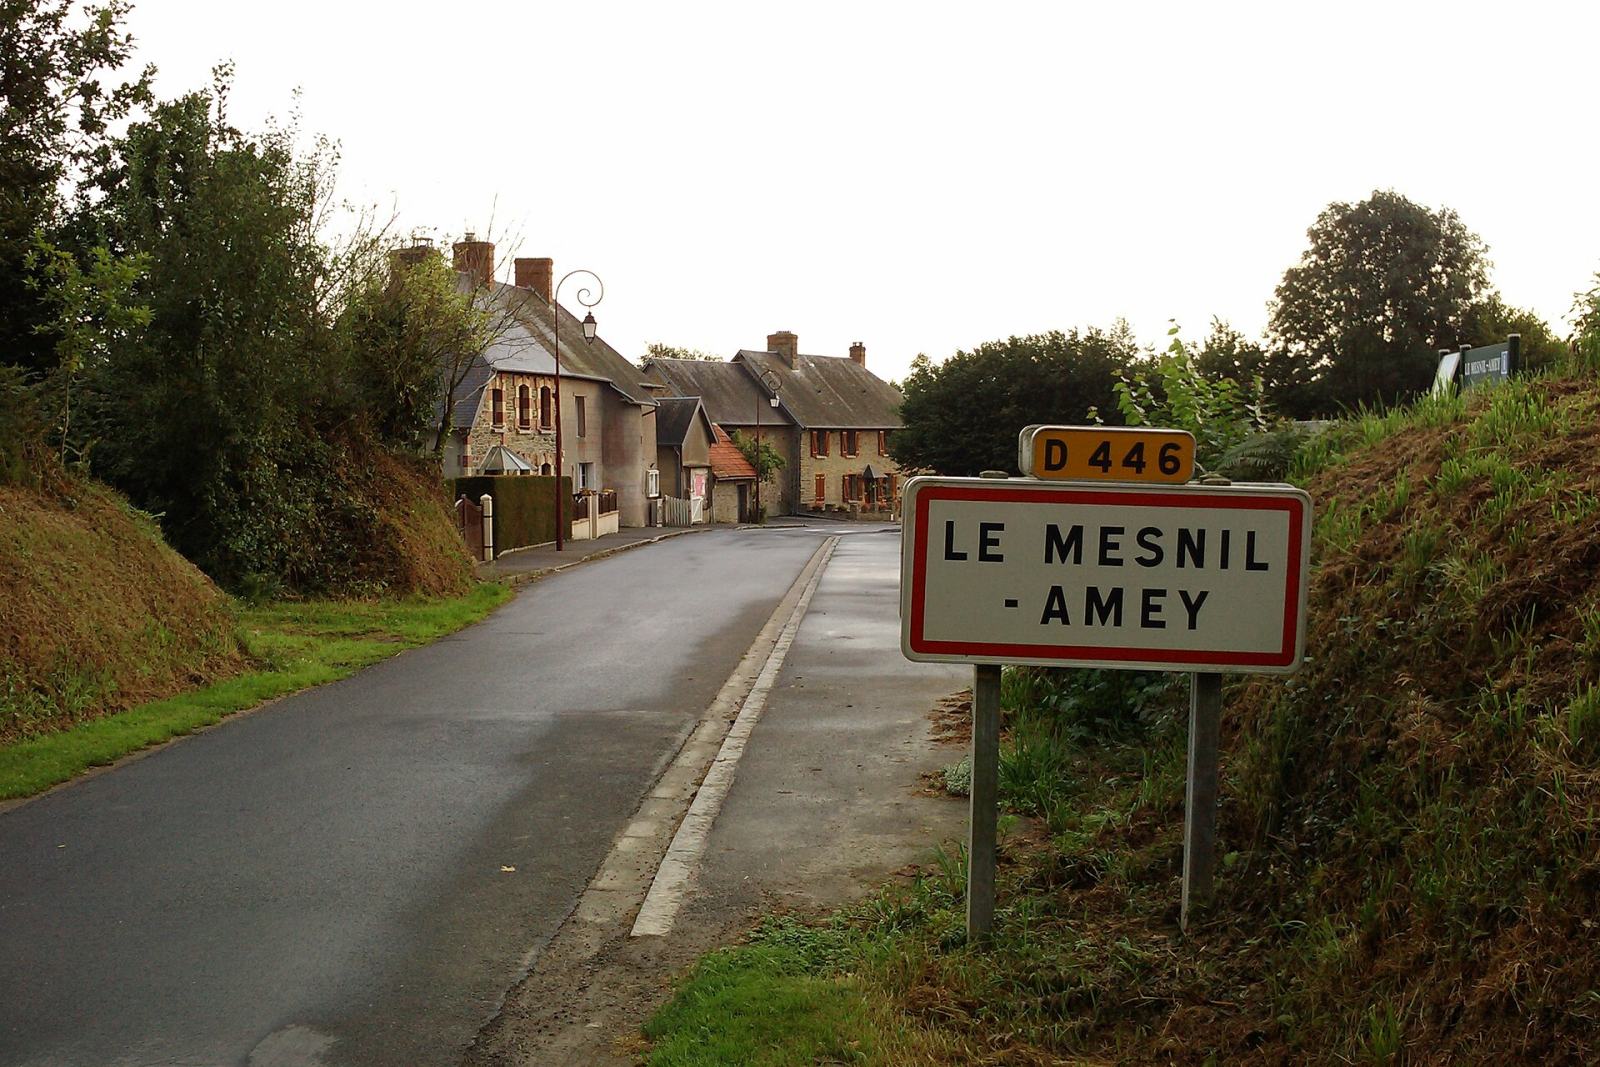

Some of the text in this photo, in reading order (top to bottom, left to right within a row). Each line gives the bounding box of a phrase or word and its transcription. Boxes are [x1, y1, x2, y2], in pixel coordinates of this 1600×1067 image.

[1044, 439, 1182, 475] D 446
[945, 521, 1269, 571] LE MESNIL
